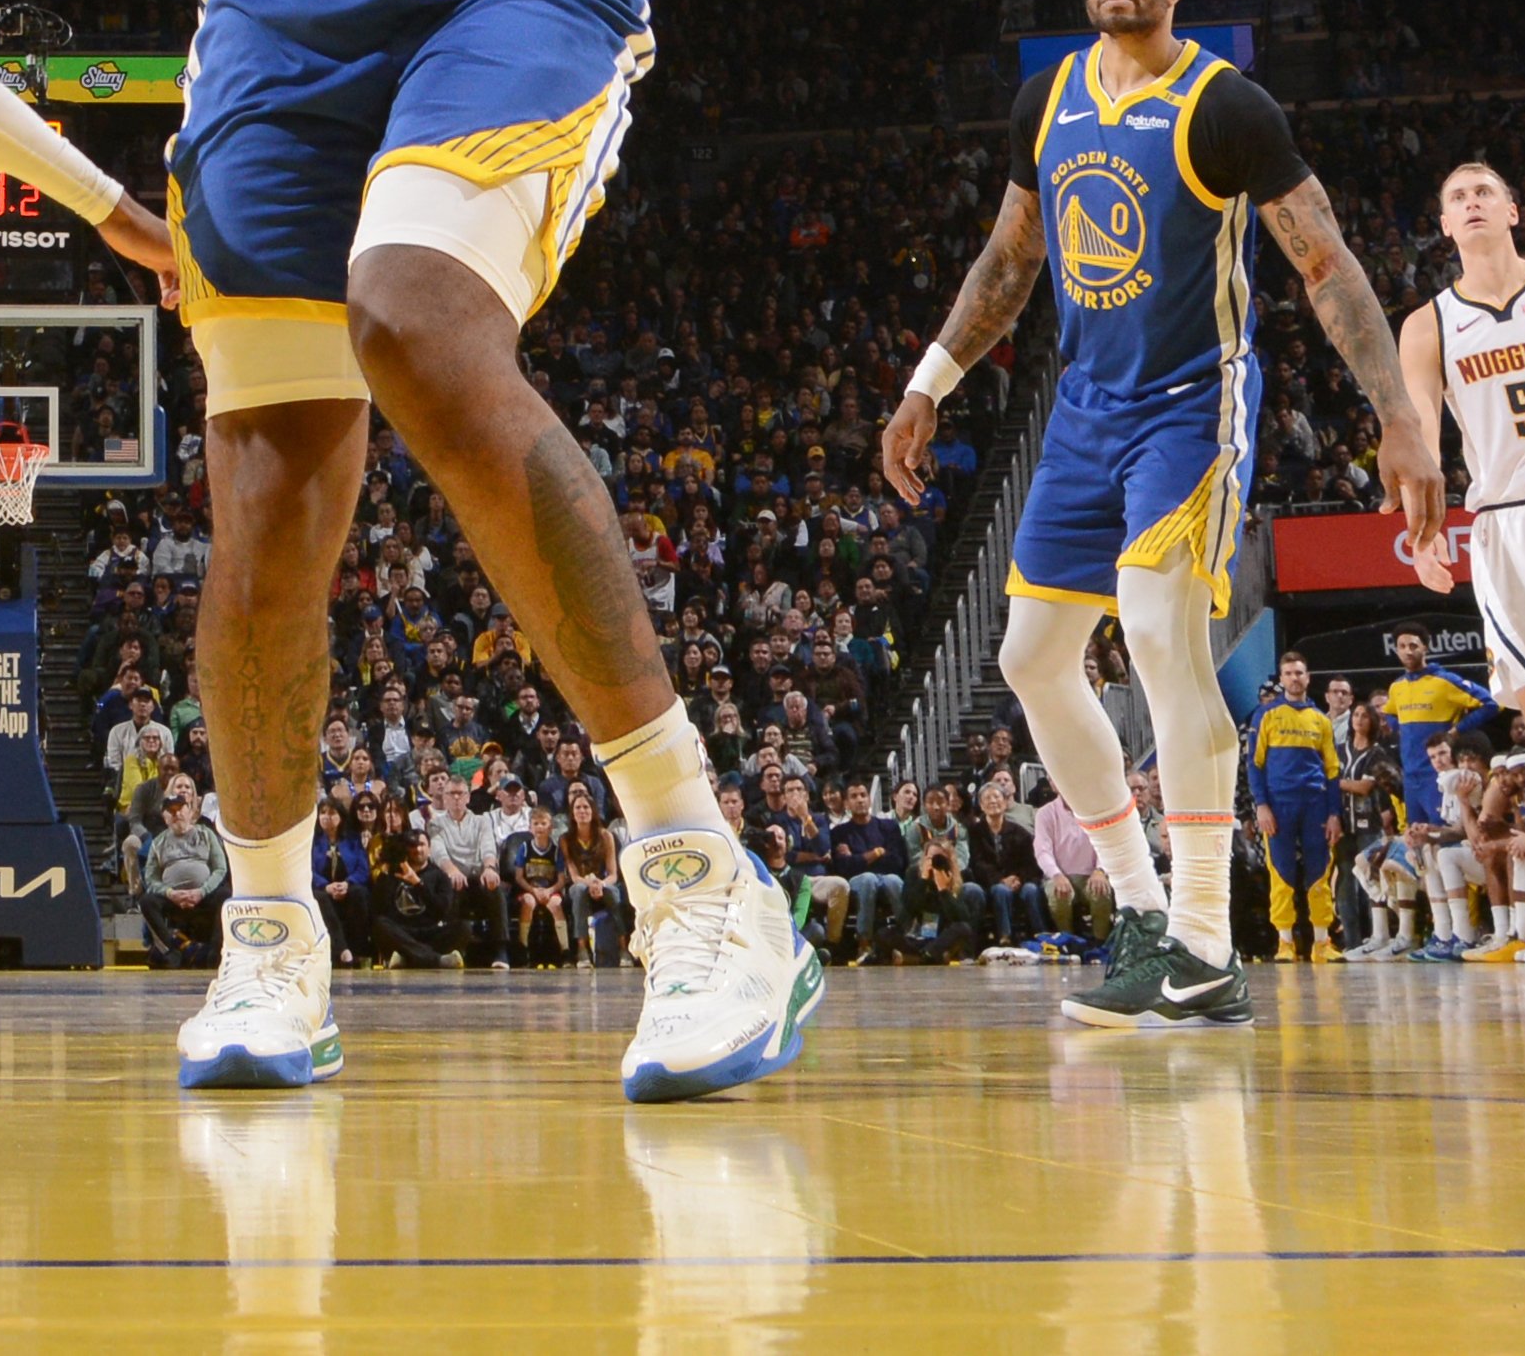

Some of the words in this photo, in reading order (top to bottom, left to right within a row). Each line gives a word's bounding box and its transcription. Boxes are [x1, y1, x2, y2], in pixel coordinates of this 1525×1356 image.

[80, 64, 127, 91] Starry
[1125, 114, 1170, 129] Rakuten
[692, 147, 713, 160] 122
[1051, 151, 1107, 185] GOLDEN
[1111, 156, 1149, 197] STATE
[1111, 202, 1129, 236] 0
[0, 707, 28, 739] App
